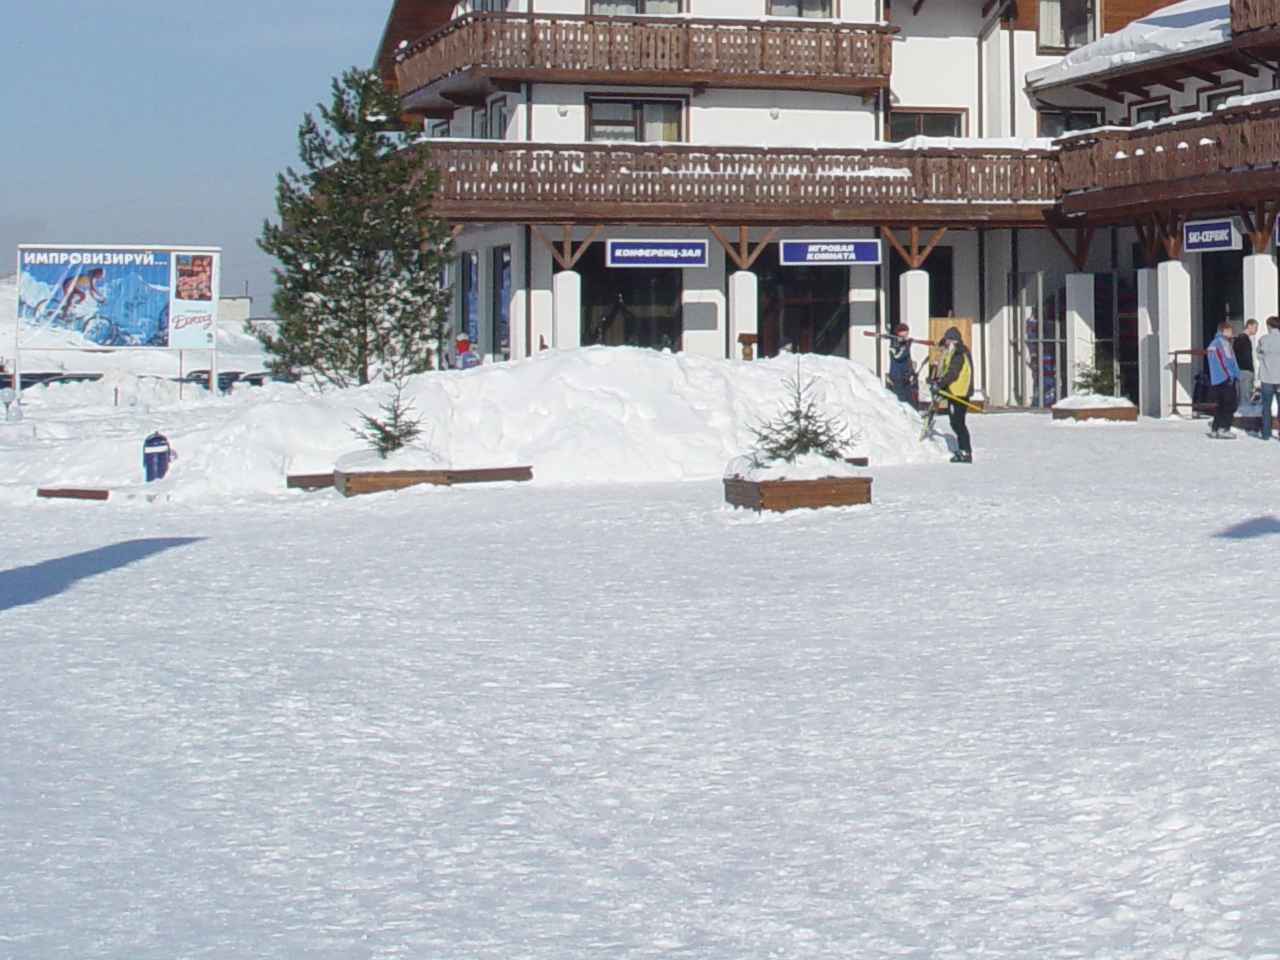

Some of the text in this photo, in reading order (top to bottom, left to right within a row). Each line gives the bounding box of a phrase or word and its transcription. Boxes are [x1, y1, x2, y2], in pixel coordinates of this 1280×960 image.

[614, 247, 703, 259] КОНФЕРЕНЦ-ЗАЛ
[807, 244, 855, 253] ИГРОВАЯ
[24, 250, 168, 266] ИМПРОВИЗИРУЙ...
[806, 252, 857, 261] КОМНАТА
